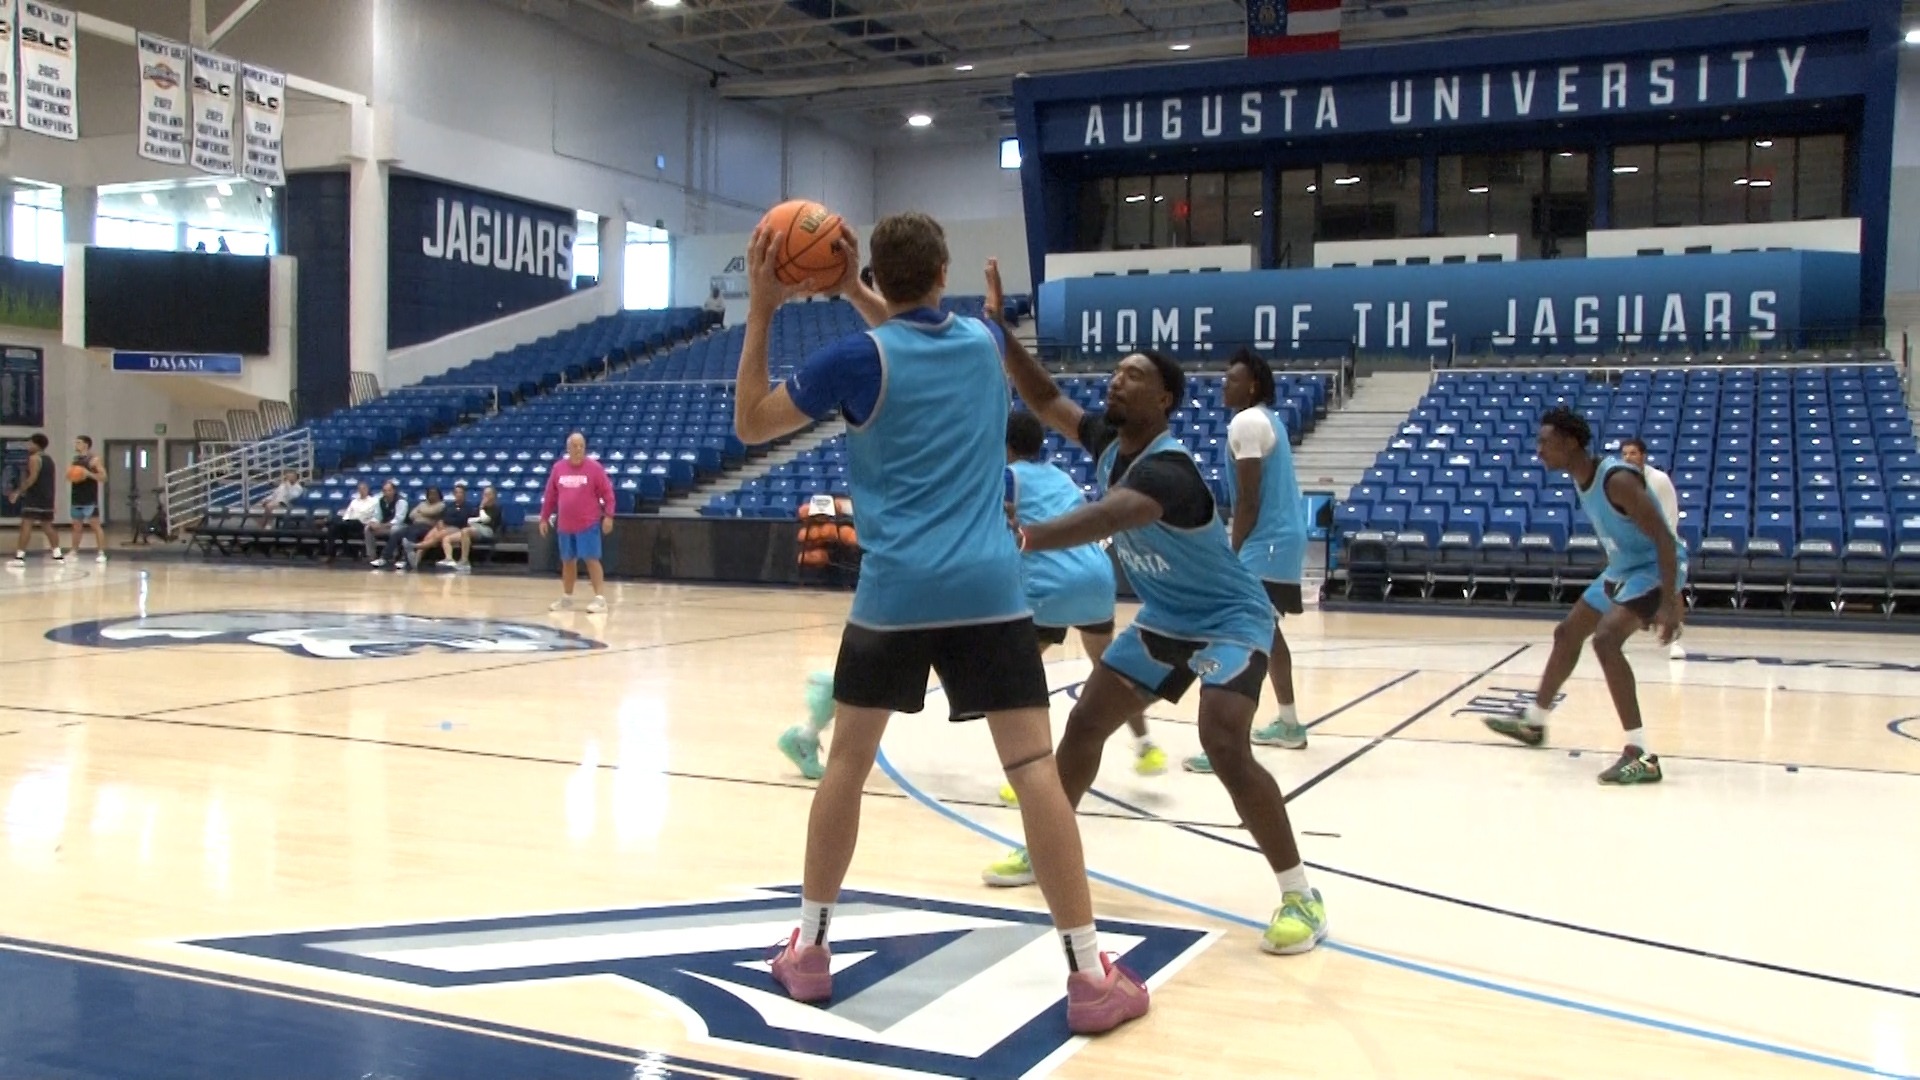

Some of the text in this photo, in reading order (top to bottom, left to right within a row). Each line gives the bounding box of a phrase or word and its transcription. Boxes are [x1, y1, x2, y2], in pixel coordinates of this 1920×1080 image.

[21, 26, 71, 52] SLC
[193, 76, 231, 98] SLC
[1084, 45, 1807, 146] AUGUSTA UNIVERSITY
[244, 89, 279, 110] SLC
[148, 111, 184, 128] OUTHLAND
[195, 121, 230, 141] SOUTHLAN
[144, 141, 182, 159] CHAMPION
[422, 197, 578, 281] JAGUARS
[1081, 291, 1777, 352] HOME OF THE JAGUARS
[149, 357, 204, 370] DASANI
